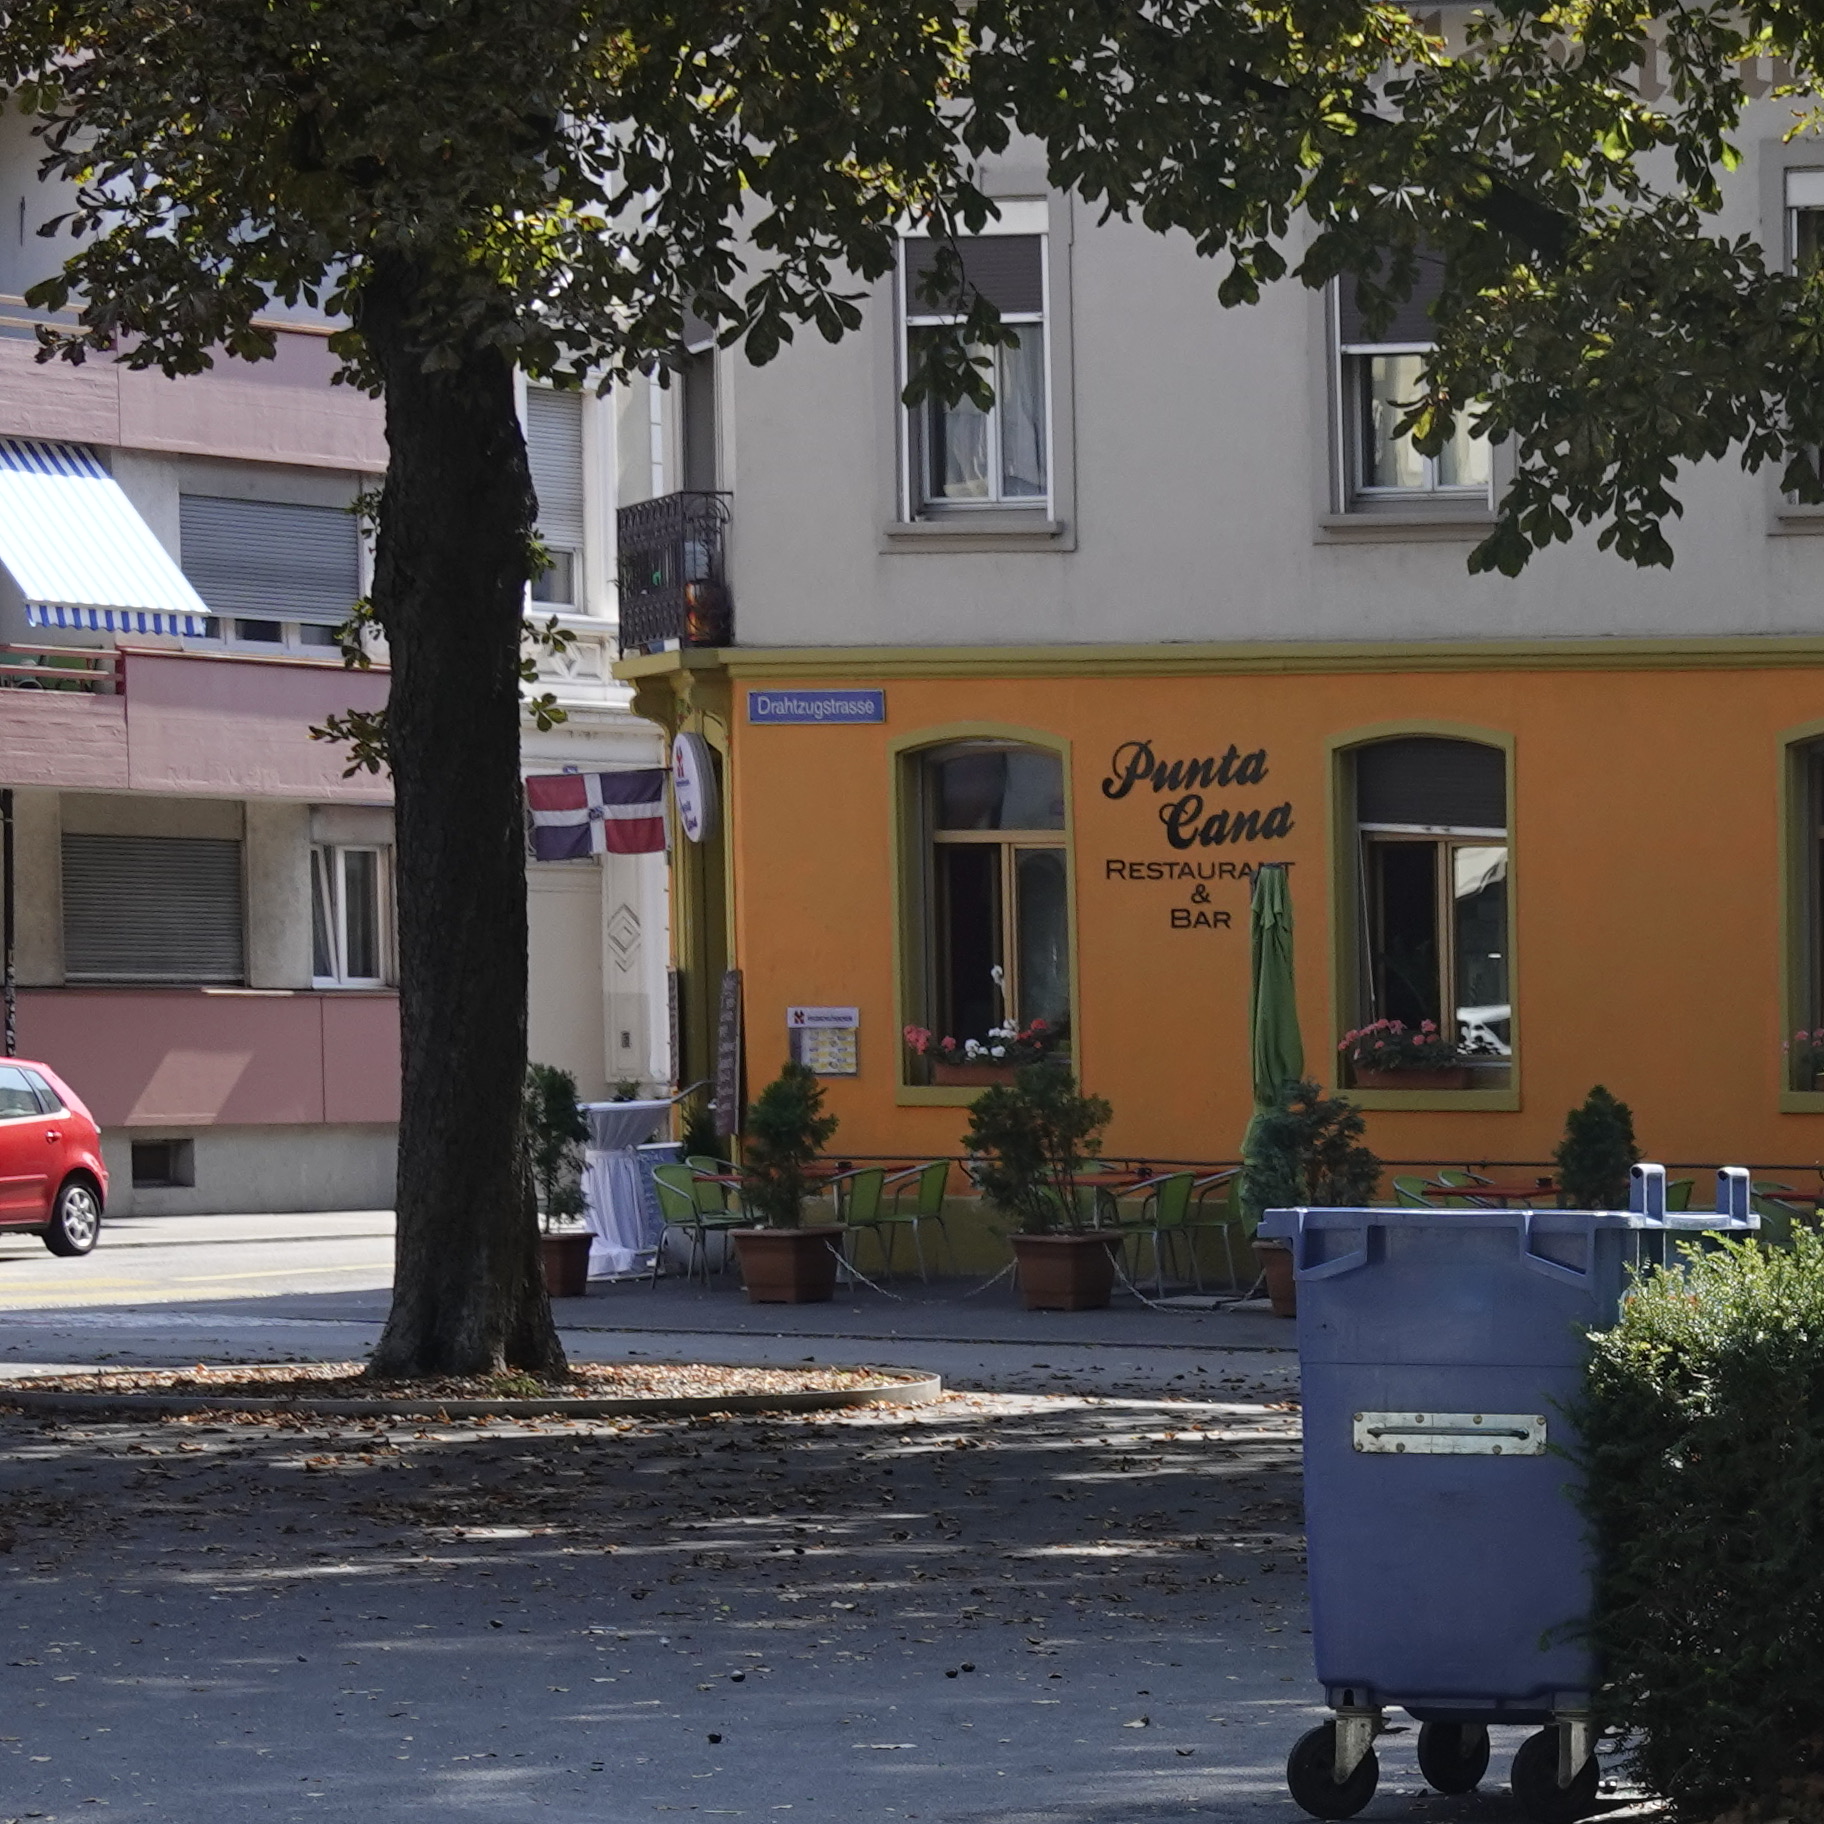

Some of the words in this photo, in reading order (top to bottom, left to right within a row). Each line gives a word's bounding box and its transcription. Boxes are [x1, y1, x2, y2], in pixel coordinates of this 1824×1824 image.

[757, 695, 875, 720] Drahtzugstrasse
[1102, 739, 1269, 799] Punta
[1158, 794, 1295, 850] Cana
[1106, 859, 1295, 880] RESTAURAT
[1190, 883, 1211, 904] &
[1170, 908, 1231, 929] BAR
